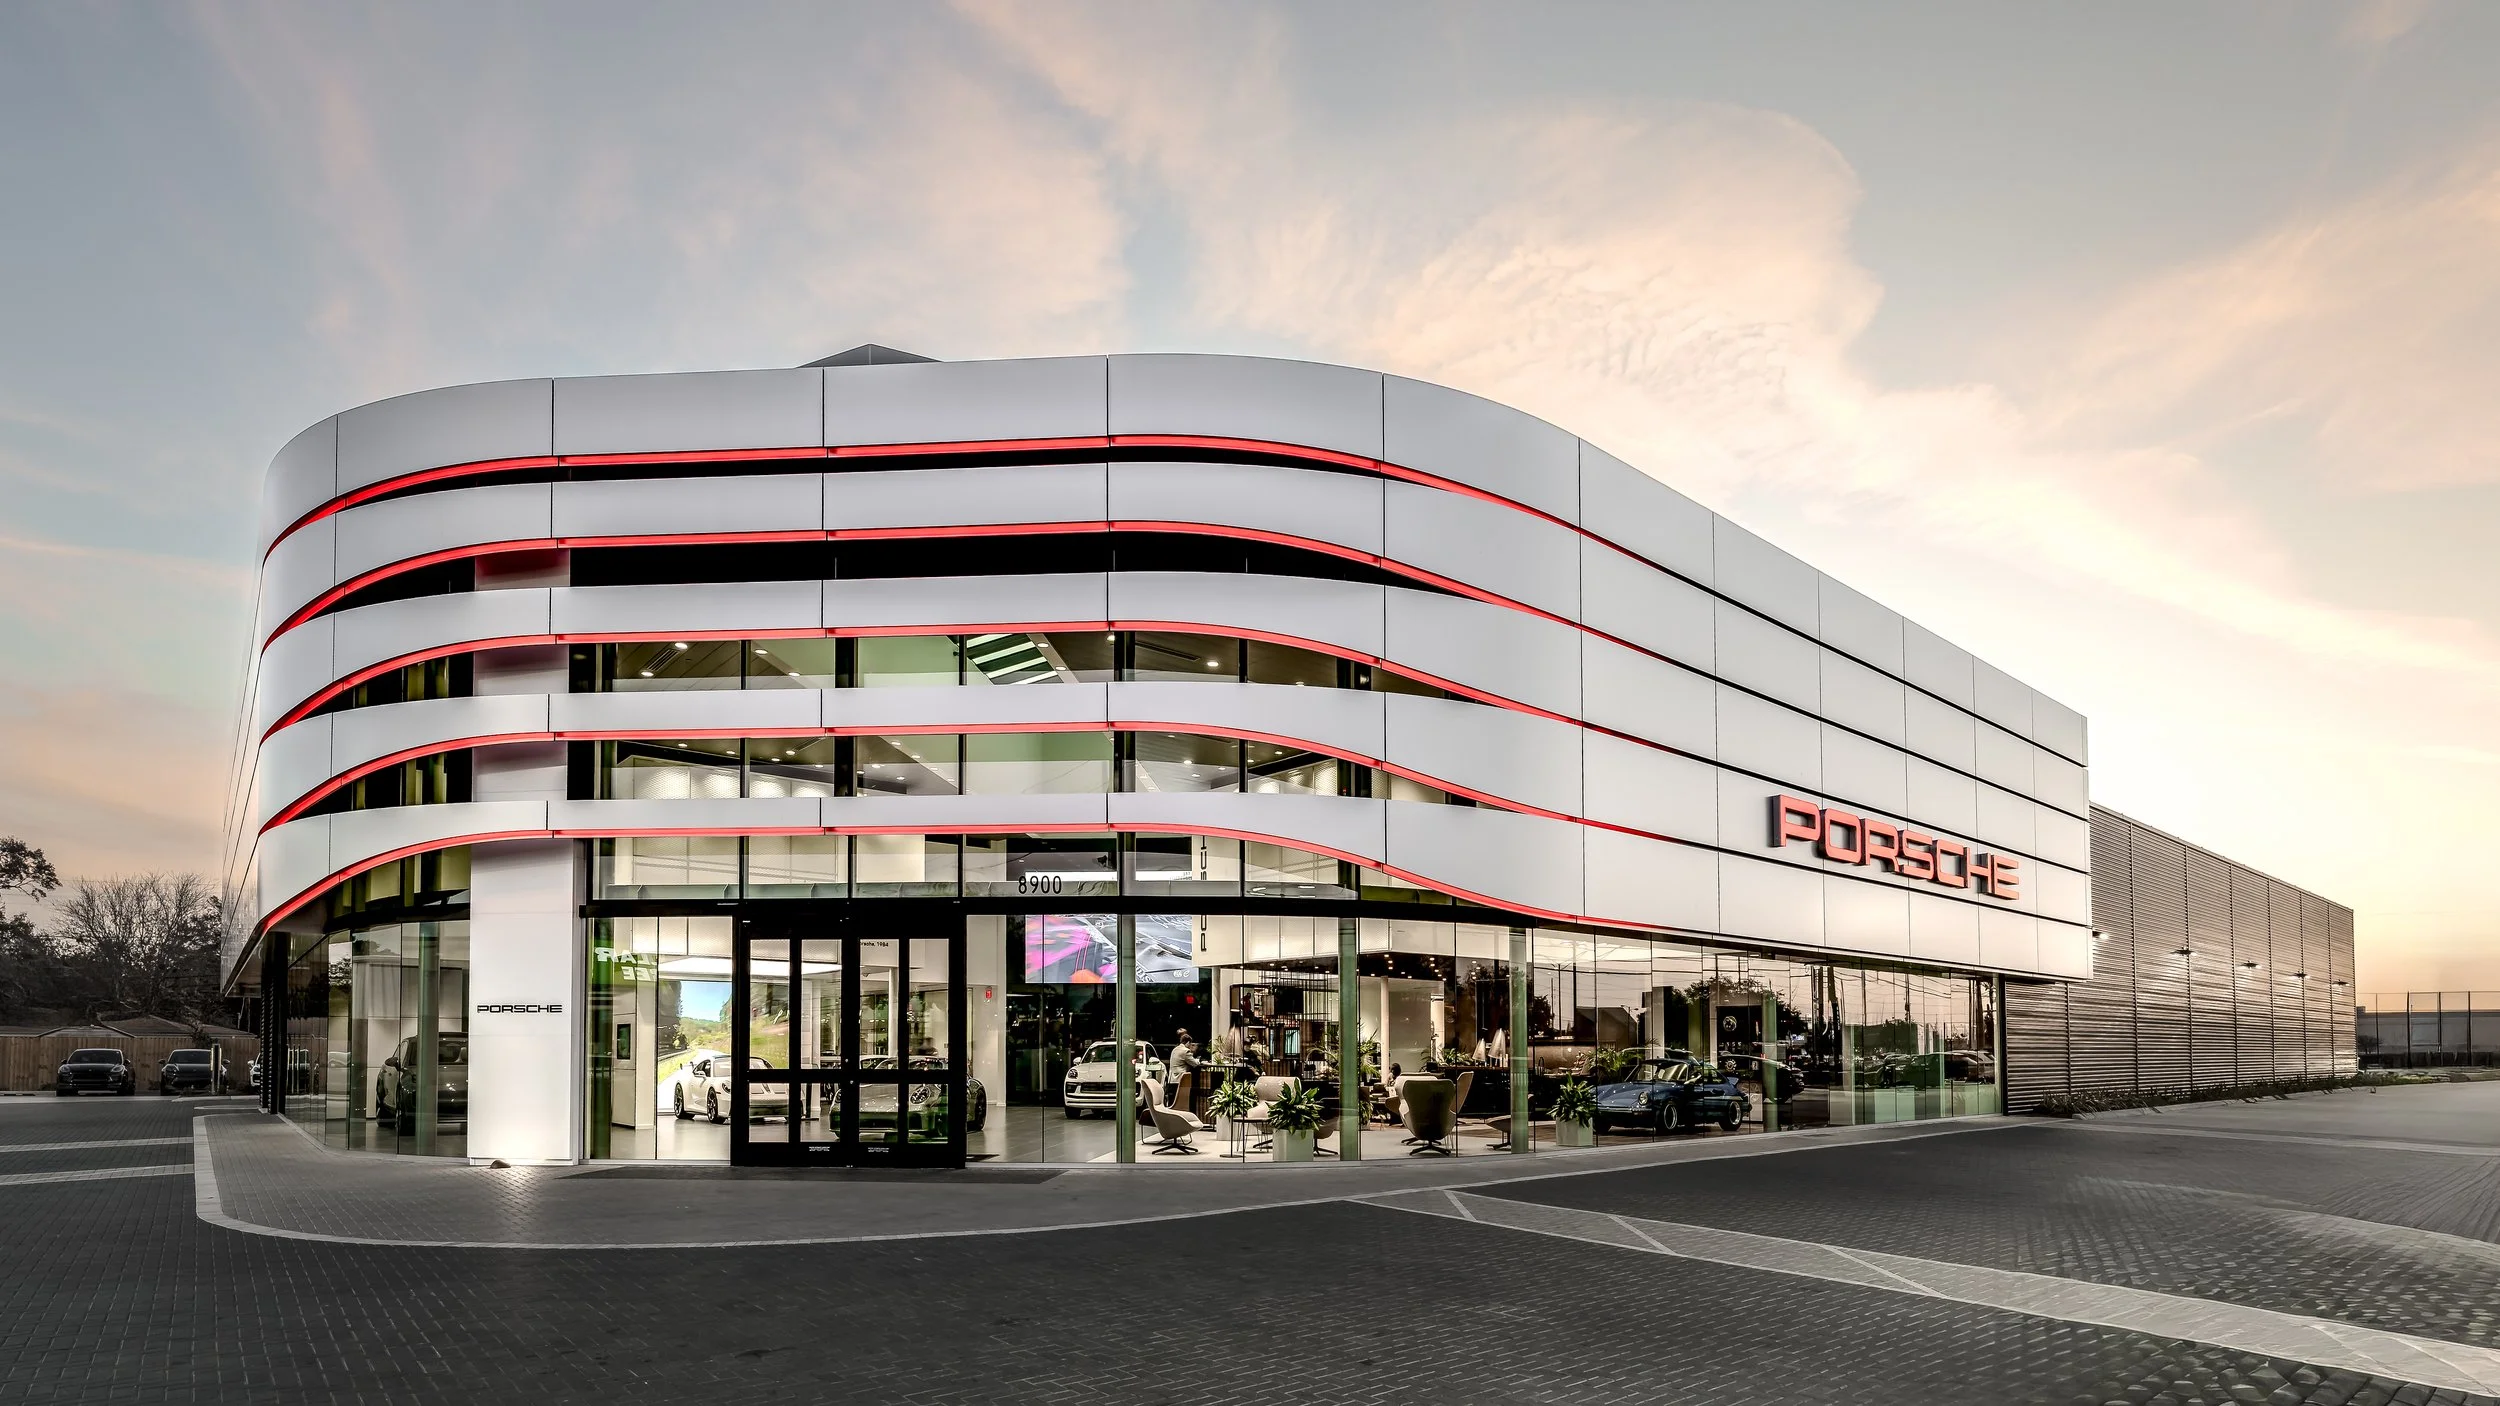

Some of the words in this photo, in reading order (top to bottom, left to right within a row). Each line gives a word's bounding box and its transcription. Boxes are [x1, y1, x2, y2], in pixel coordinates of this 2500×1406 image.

[1773, 794, 2019, 900] PORSCHE
[1018, 875, 1062, 894] 8900
[477, 1004, 563, 1013] PORSCHE
